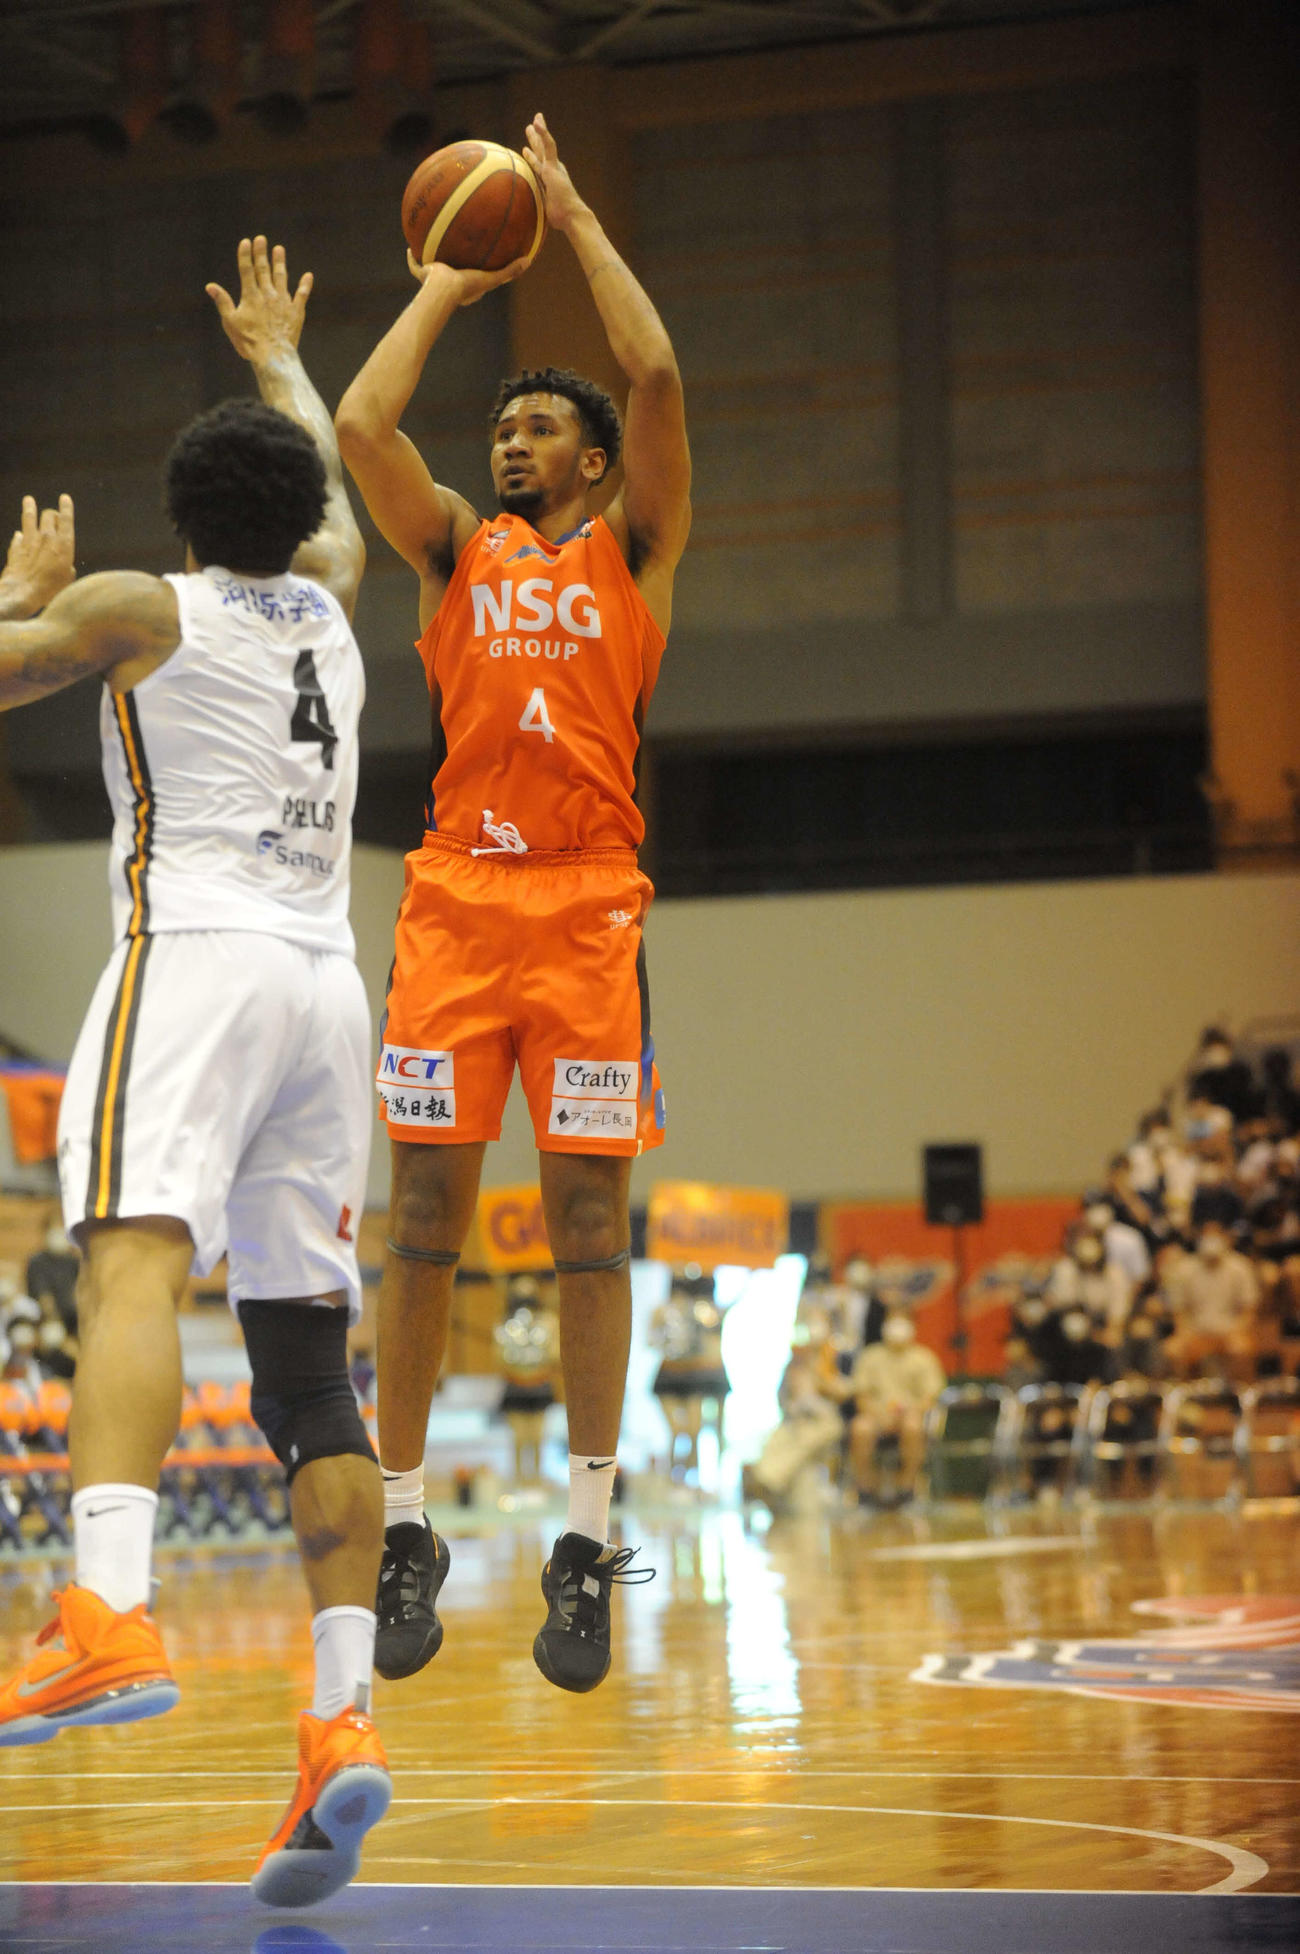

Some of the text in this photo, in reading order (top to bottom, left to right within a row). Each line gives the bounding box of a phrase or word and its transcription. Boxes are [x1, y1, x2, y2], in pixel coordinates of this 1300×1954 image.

[470, 577, 602, 639] NSG
[489, 637, 579, 661] GROUP
[291, 649, 338, 771] 4
[518, 688, 557, 744] 4
[383, 1053, 446, 1080] NCT
[565, 1066, 632, 1095] Crafty
